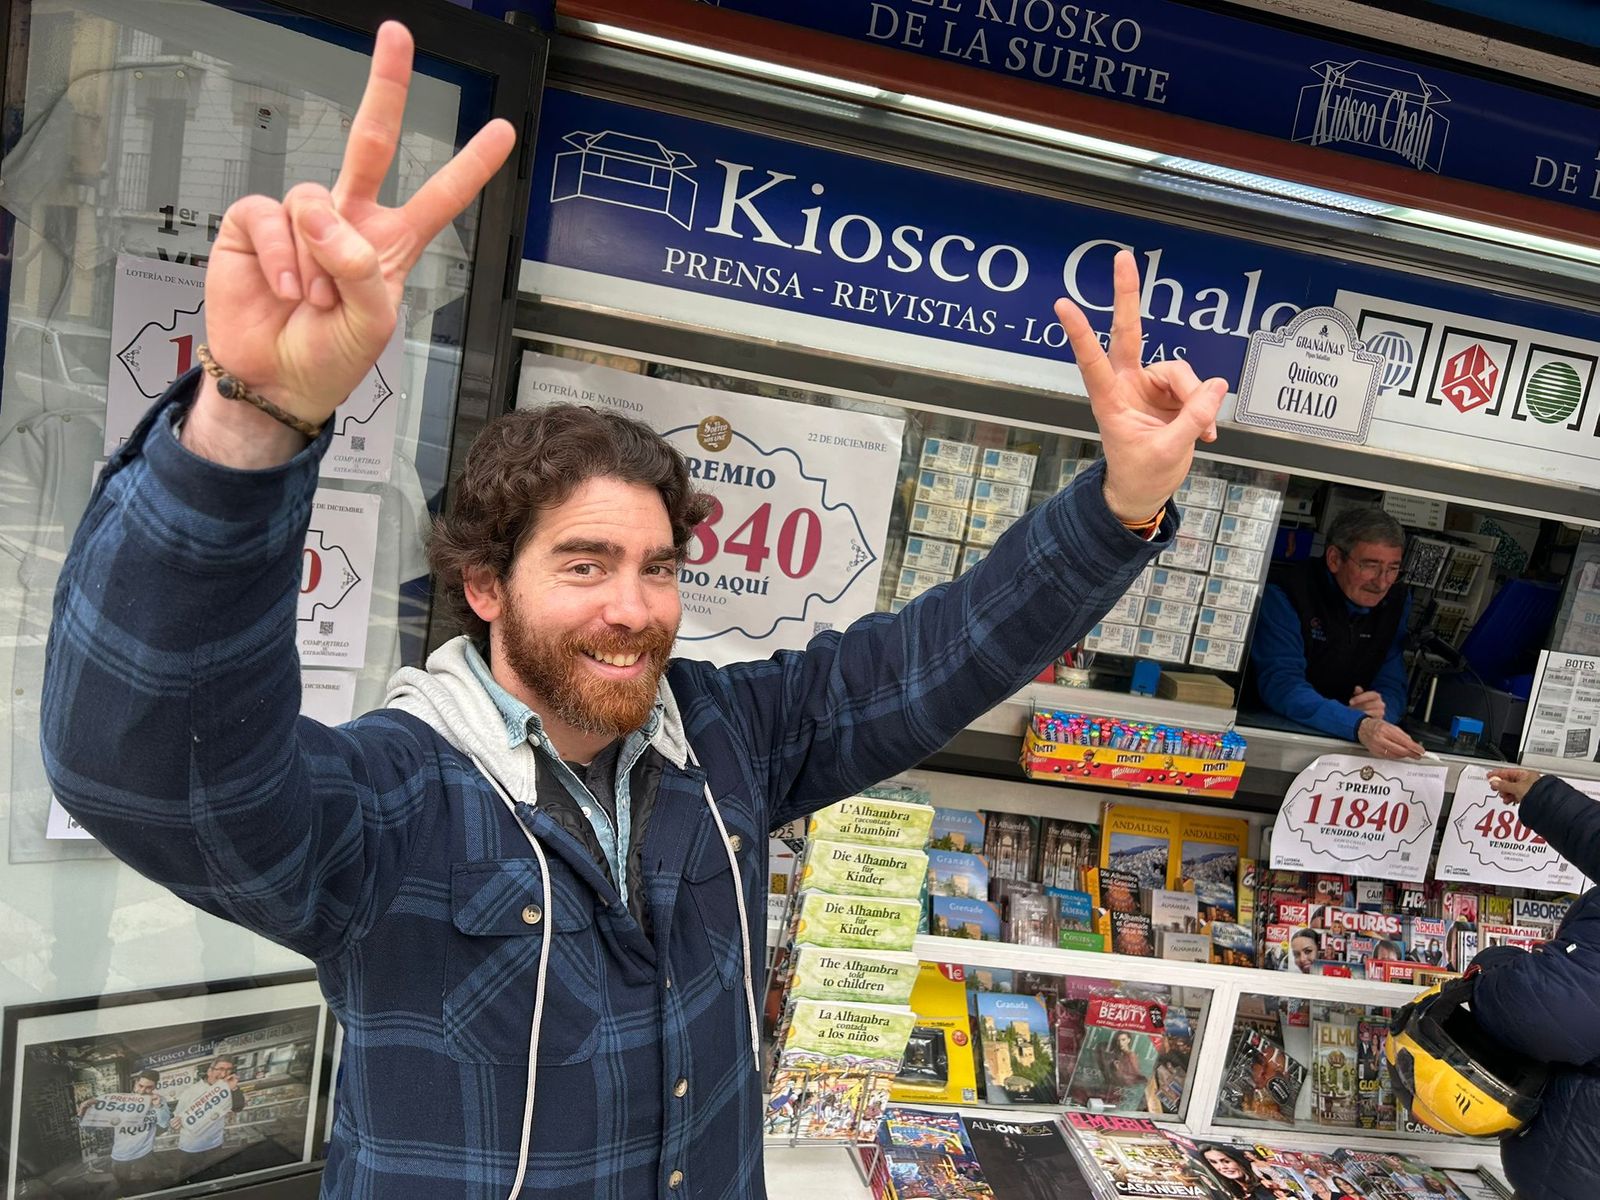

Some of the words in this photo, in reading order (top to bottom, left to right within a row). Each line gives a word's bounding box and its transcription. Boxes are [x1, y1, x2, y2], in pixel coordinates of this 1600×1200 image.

[976, 0, 1142, 53] KIOSKO
[866, 2, 927, 48] DE
[940, 20, 992, 64] LA
[1004, 36, 1170, 104] SUERTE
[1310, 63, 1377, 146] Kiosco
[1379, 88, 1433, 171] Chalo
[1530, 155, 1581, 195] DE
[705, 158, 1030, 292] Kiosco
[126, 268, 162, 282] LOTERÍA
[178, 278, 205, 288] NAVID
[662, 246, 805, 300] PRENSA
[831, 280, 997, 336] REVISTAS
[1021, 318, 1187, 366] LOEÍAS
[1296, 336, 1345, 356] GRANAÍNAS
[1288, 362, 1338, 388] Quiosco
[532, 381, 578, 398] LOTERÍA
[581, 390, 595, 401] DE
[597, 394, 644, 413] NAVIDAD
[1277, 386, 1337, 419] CHALO
[808, 433, 818, 442] 22
[819, 435, 833, 444] DE
[834, 437, 888, 452] DICIEMBRE
[686, 457, 776, 490] REMIO
[327, 504, 364, 514] DICIEMBRE
[682, 492, 822, 580] 840
[715, 576, 769, 596] AQUÍ
[692, 591, 727, 605] CHALO
[684, 603, 712, 615] NADA
[1565, 659, 1595, 670] BOTES
[1346, 782, 1391, 796] PREMIO
[840, 803, 911, 821] L'Alhambra
[935, 813, 973, 824] Granada
[1304, 793, 1409, 834] 11840
[854, 817, 891, 826] raccontata
[998, 821, 1030, 832] Alhambra
[1112, 820, 1169, 835] ANDALUSIA
[840, 824, 851, 833] ai
[853, 824, 901, 838] bambini
[1060, 830, 1092, 840] Alhambra
[1183, 829, 1240, 842] ANDALUSIEN
[1320, 827, 1359, 838] VENDIDO
[1361, 831, 1385, 842] AQUÍ
[1489, 840, 1525, 851] VENDIDO
[1525, 845, 1547, 854] AQUÍ
[832, 850, 852, 862] Die
[853, 853, 908, 870] Alhambra
[936, 854, 976, 867] Granada
[861, 864, 874, 873] für
[846, 870, 885, 885] Kinder
[825, 903, 845, 914] Die
[848, 905, 901, 920] Alhambra
[949, 902, 985, 915] Grenade
[1280, 904, 1307, 916] DIEZ
[1516, 901, 1568, 921] LABORES
[855, 916, 868, 925] für
[1113, 912, 1150, 923] L'Alhambra
[840, 924, 879, 937] Kinder
[1266, 926, 1288, 936] DIEZ
[1414, 917, 1446, 936] SEMANA
[819, 957, 841, 970] The
[842, 960, 899, 976] Alhambra
[848, 971, 865, 979] told
[823, 977, 835, 987] to
[837, 977, 885, 992] children
[995, 1000, 1029, 1010] Granada
[818, 1010, 832, 1020] La
[835, 1011, 891, 1027] Alhambra
[1099, 1006, 1147, 1023] BEAUTY
[836, 1022, 868, 1032] contada
[828, 1029, 844, 1040] los
[847, 1031, 879, 1043] niños
[1320, 1026, 1336, 1044] EL
[148, 1049, 185, 1065] Kiosco
[156, 1075, 191, 1091] 05490
[110, 1095, 145, 1103] PREMIO
[190, 1086, 221, 1110] PREMIO
[94, 1101, 145, 1114] 05490
[186, 1088, 230, 1126] 05490
[1067, 1112, 1088, 1130] EL
[1086, 1115, 1157, 1134] MUEBLE
[1115, 1181, 1157, 1194] CASA
[1157, 1184, 1206, 1196] NUEVA
